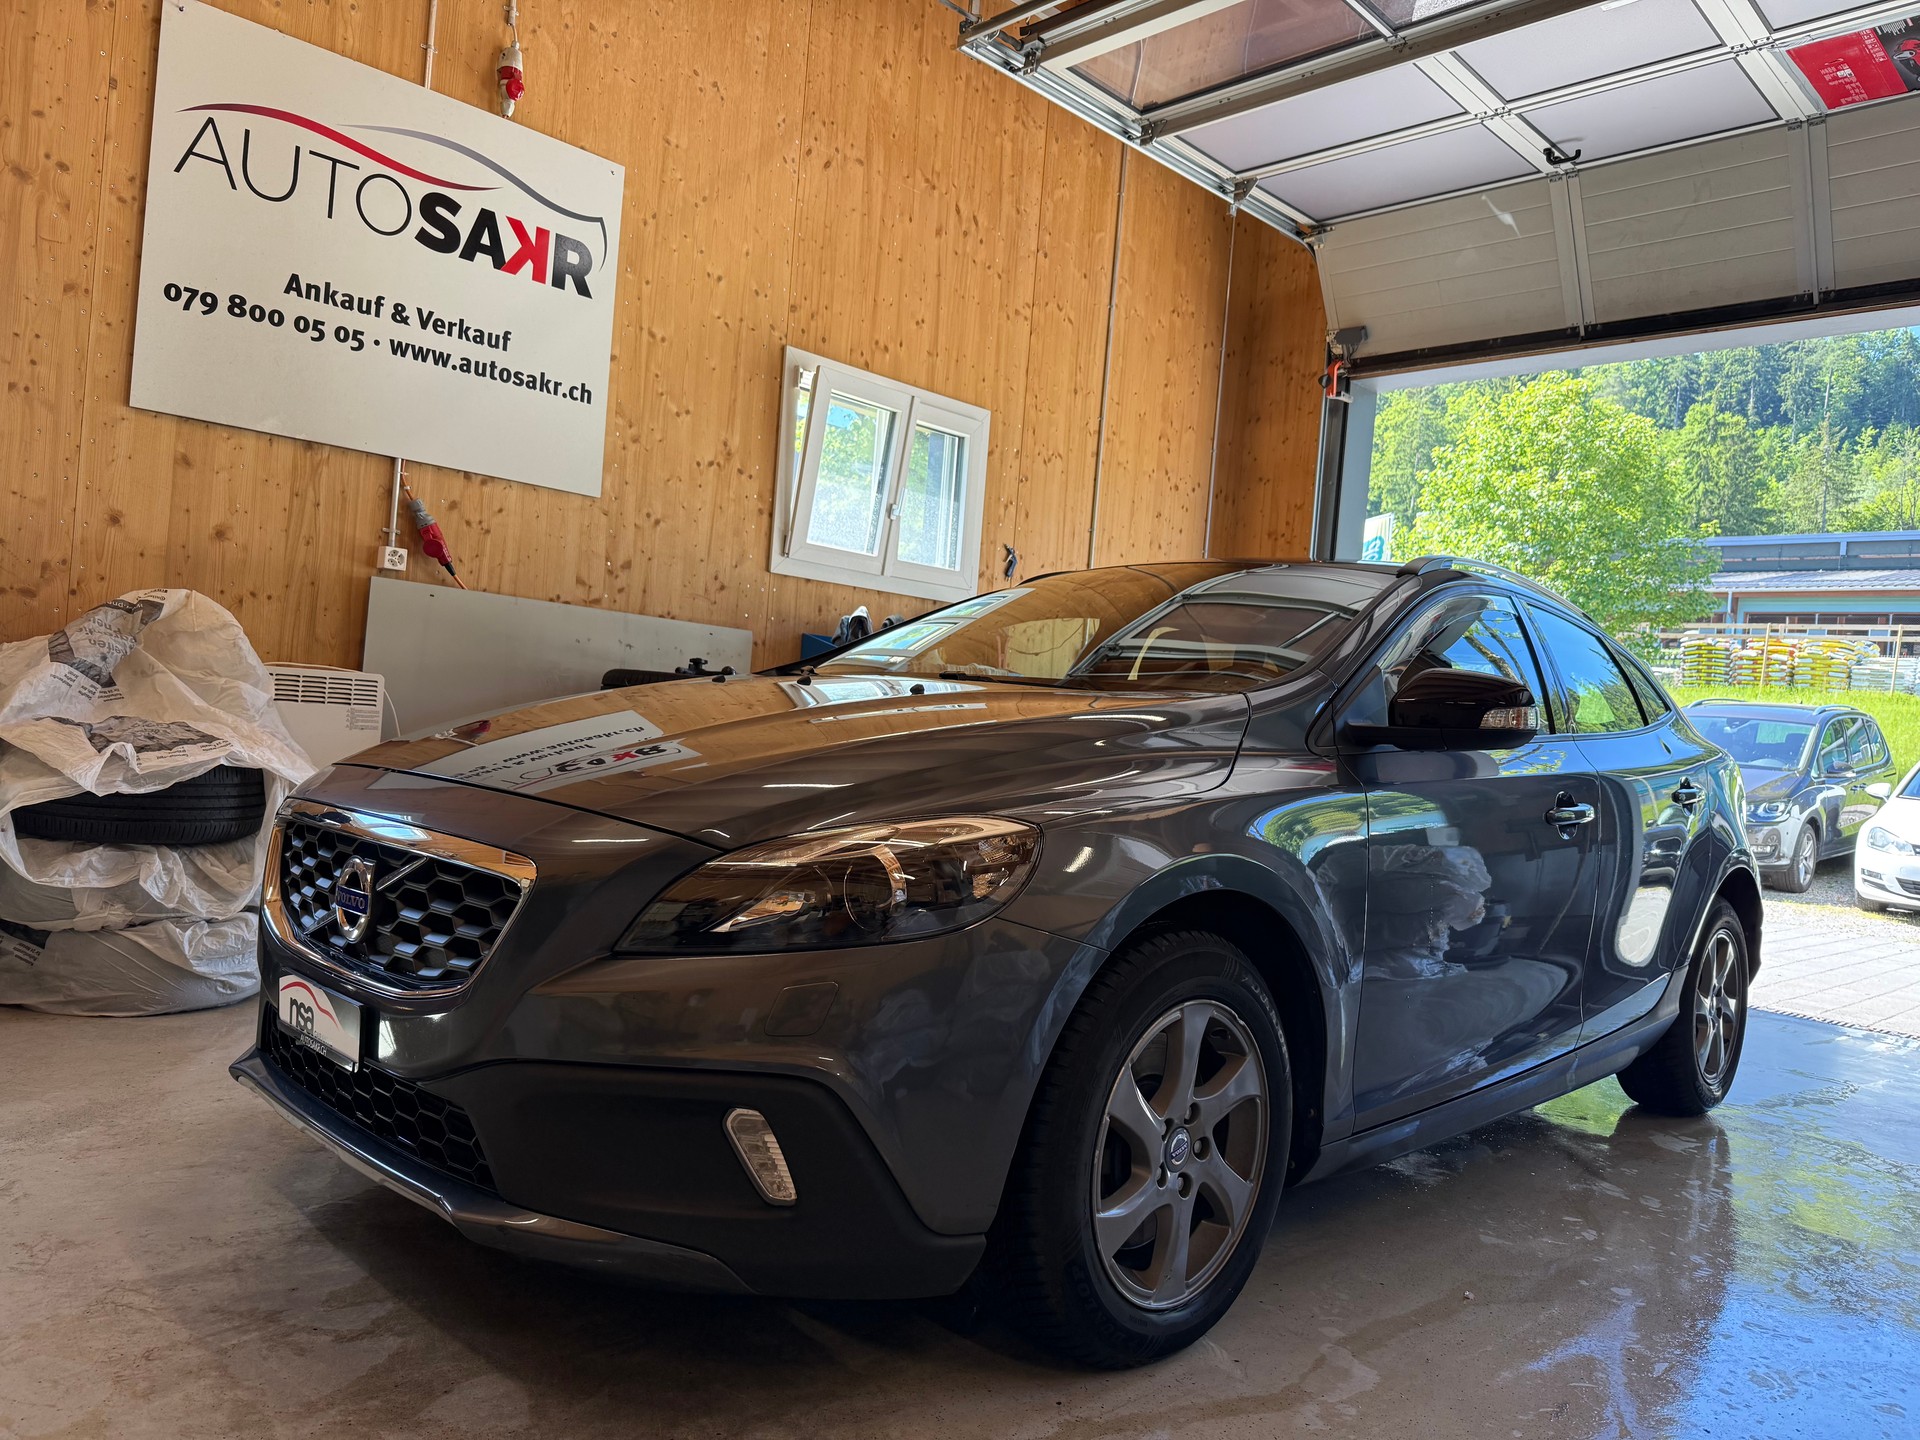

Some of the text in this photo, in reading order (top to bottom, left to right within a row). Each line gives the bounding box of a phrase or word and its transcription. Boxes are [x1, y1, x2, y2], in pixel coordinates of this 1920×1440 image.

[283, 273, 511, 351] Ankauf & Verkauf
[164, 283, 218, 315] 079
[227, 294, 284, 327] 800
[294, 316, 325, 342] 05
[334, 326, 364, 351] 05
[390, 339, 591, 404] www.autosakr.ch
[337, 890, 366, 909] VOLVO
[289, 997, 314, 1036] nsa
